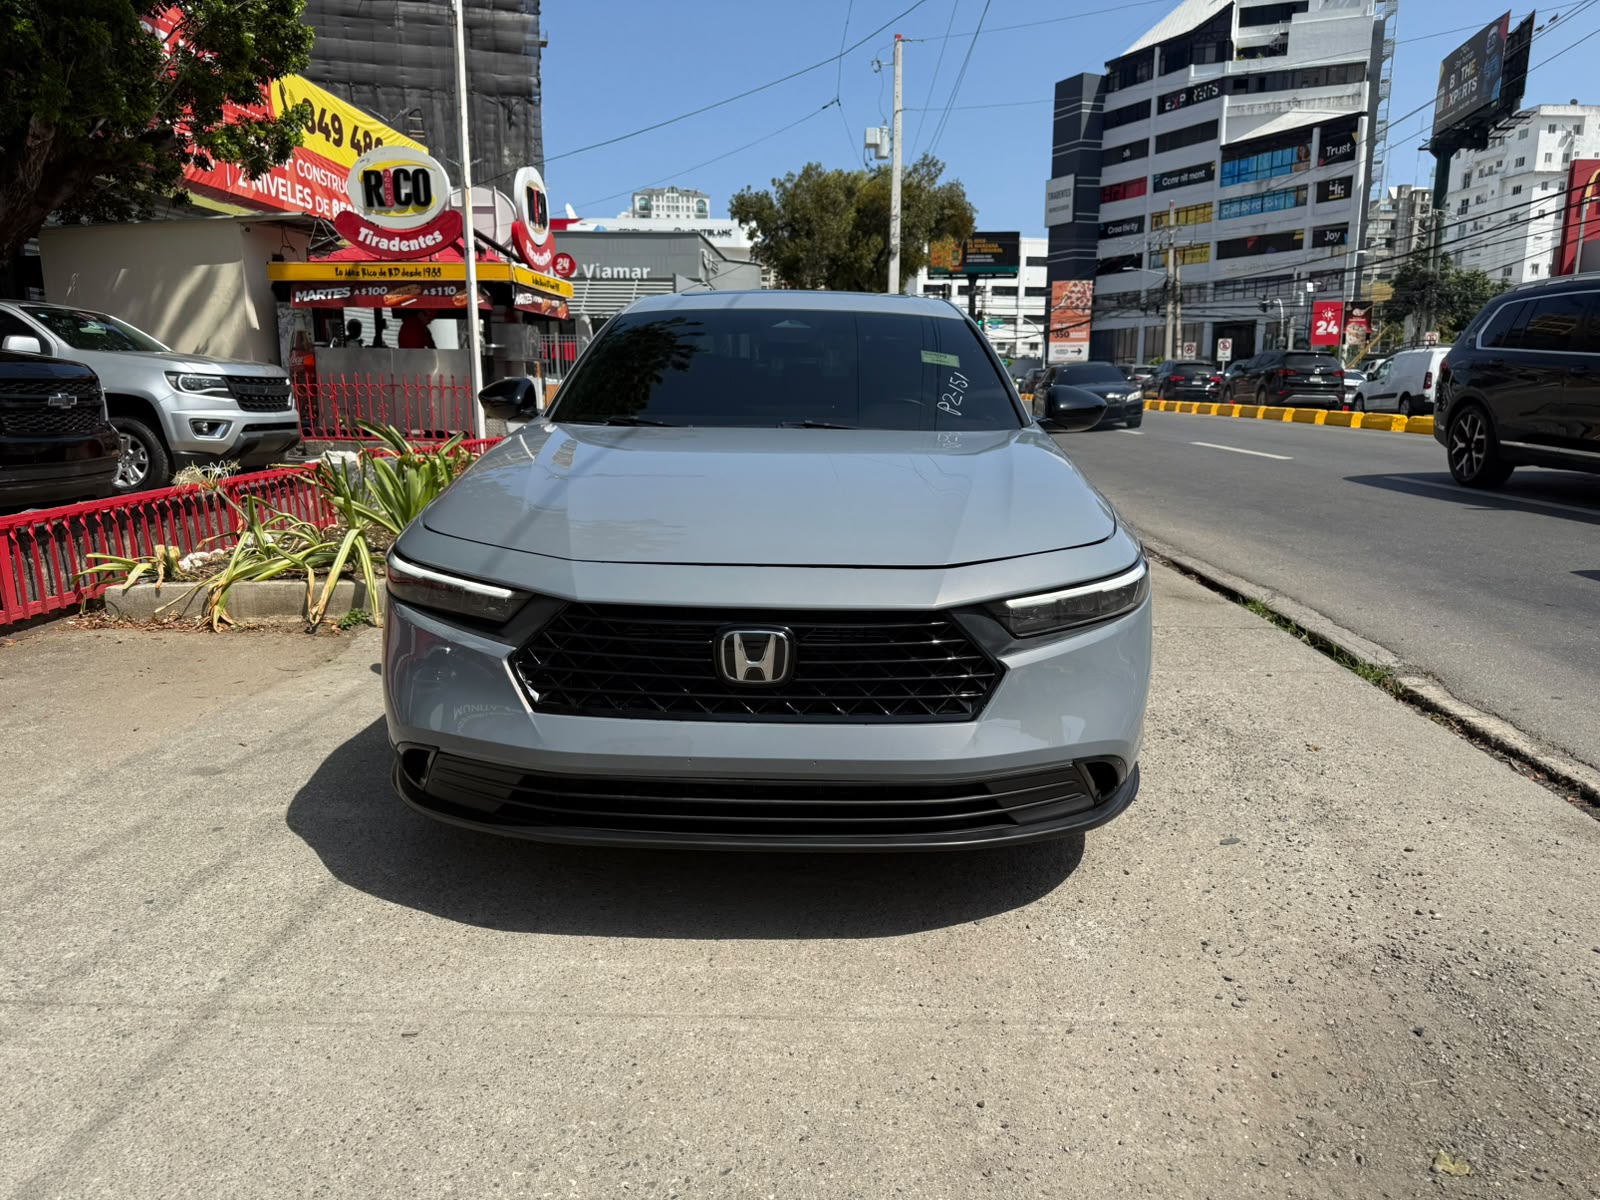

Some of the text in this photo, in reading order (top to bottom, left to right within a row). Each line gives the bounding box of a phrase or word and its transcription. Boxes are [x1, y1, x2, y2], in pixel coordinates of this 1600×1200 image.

[1461, 58, 1476, 80] THE
[1326, 143, 1351, 157] Trust
[251, 171, 323, 209] NIVELES
[315, 196, 341, 216] DE
[363, 168, 432, 208] RICO
[358, 227, 443, 252] Tiradentes
[1324, 230, 1341, 243] Joy
[423, 267, 442, 277] 1988
[582, 263, 651, 279] Viamar
[295, 287, 351, 302] MARTES
[361, 286, 388, 295] $100
[430, 286, 457, 295] $110
[1316, 320, 1339, 335] 24
